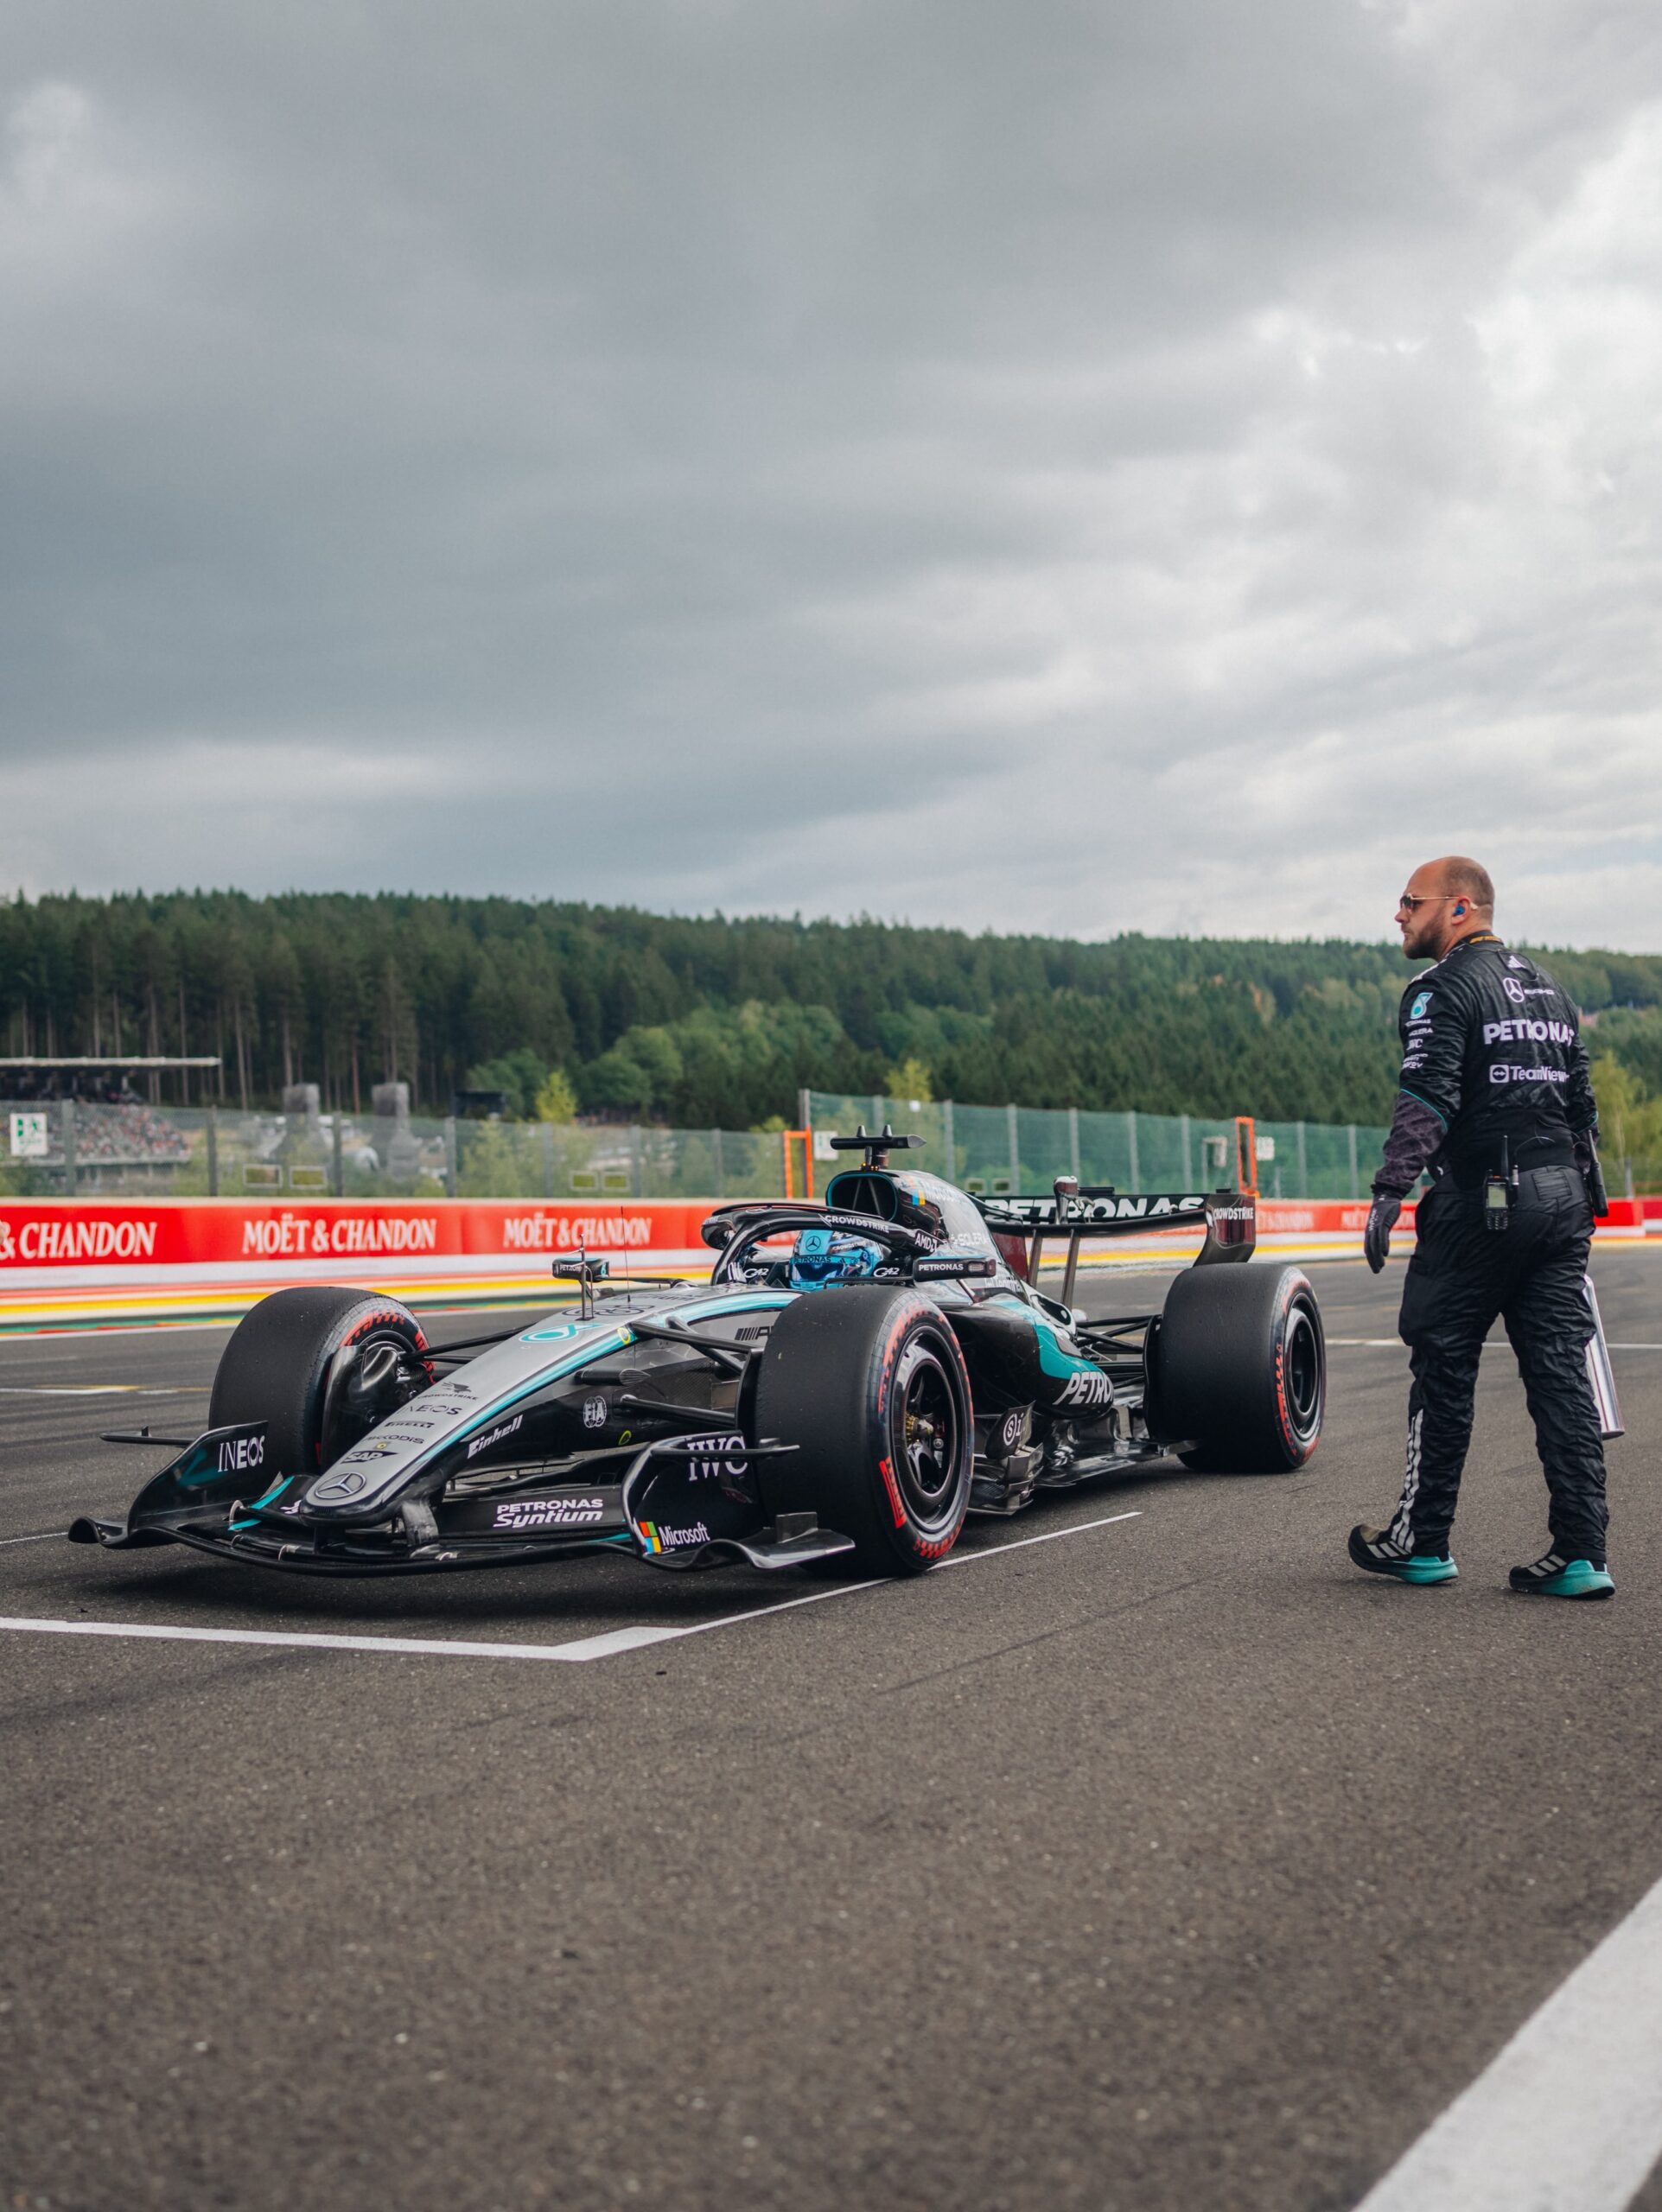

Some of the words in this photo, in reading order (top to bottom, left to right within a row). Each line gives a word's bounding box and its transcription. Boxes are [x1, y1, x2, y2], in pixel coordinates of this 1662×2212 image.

[826, 1215, 889, 1233] CROWDSTRIKE
[1213, 1205, 1253, 1221] CROWDSTRIKE
[19, 1221, 157, 1259] CHANDON
[242, 1212, 311, 1254] MOËT
[331, 1217, 437, 1251] CHANDON
[503, 1211, 557, 1248] MOËT
[571, 1217, 653, 1246] CHANDON
[914, 1232, 933, 1250] AMD
[1052, 1371, 1114, 1405] PETRO
[467, 1414, 523, 1459] Einhell
[218, 1435, 265, 1472] INEOS
[346, 1451, 384, 1461] SAP
[687, 1436, 748, 1481] IWC
[493, 1510, 603, 1529] Syntium
[497, 1498, 603, 1514] PETRONAS
[658, 1522, 710, 1546] Microsoft
